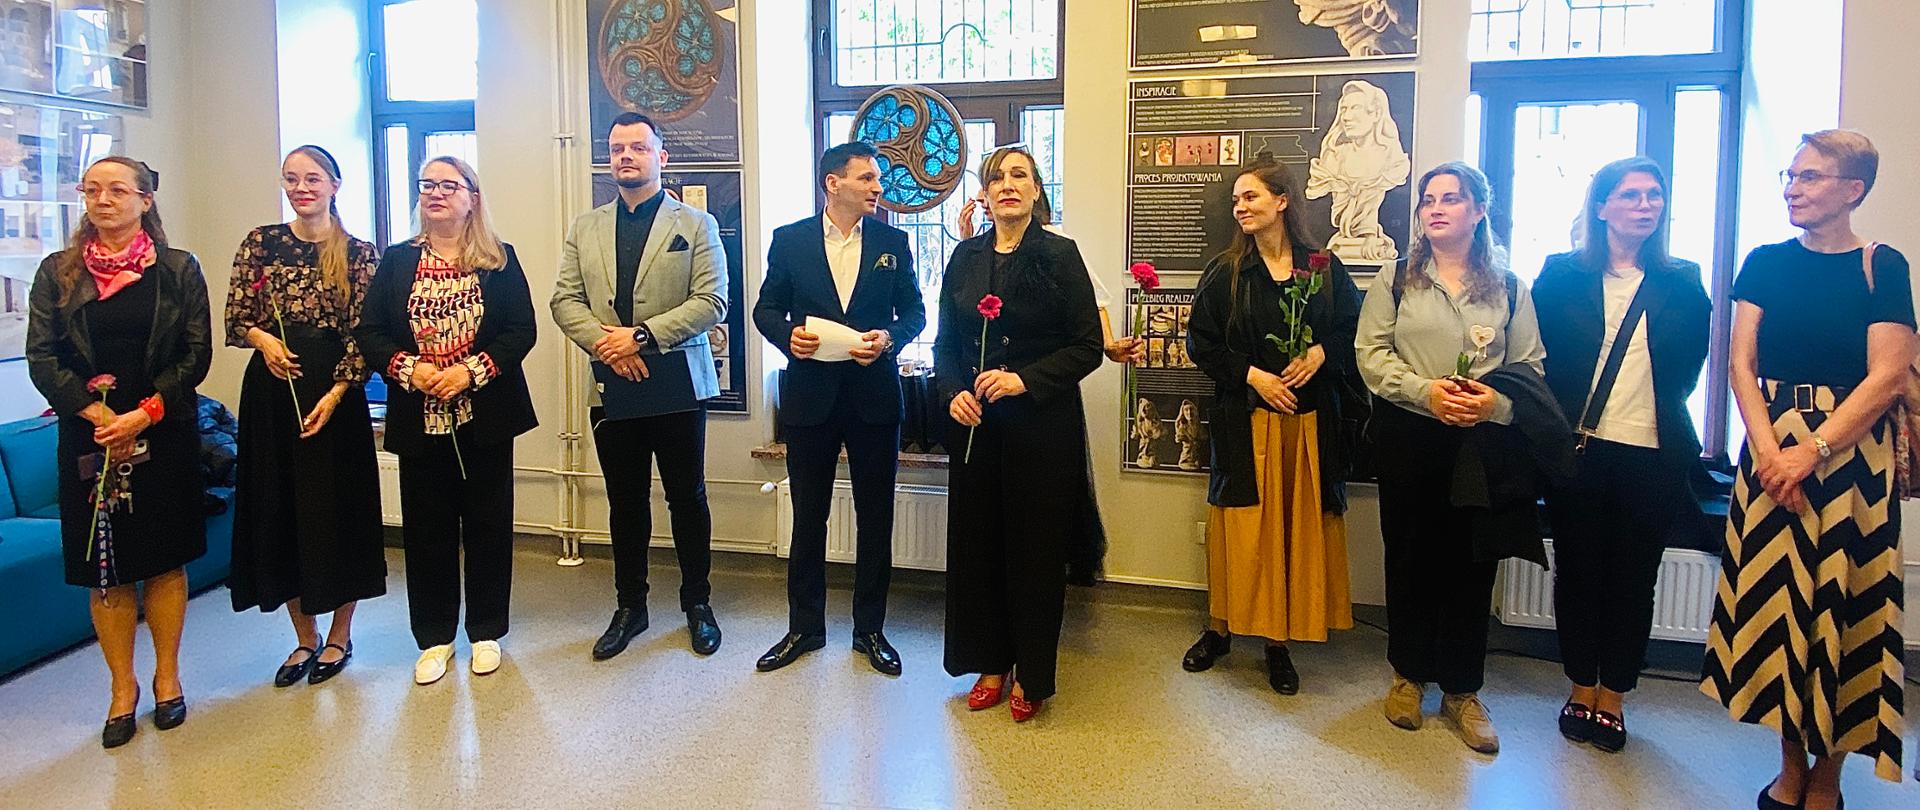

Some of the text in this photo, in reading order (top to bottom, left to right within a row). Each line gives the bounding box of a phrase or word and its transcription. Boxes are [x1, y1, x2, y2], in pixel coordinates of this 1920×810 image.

[1136, 87, 1177, 97] INSPIRACJE
[1134, 172, 1223, 183] PROCES PROJEKTOWANIA
